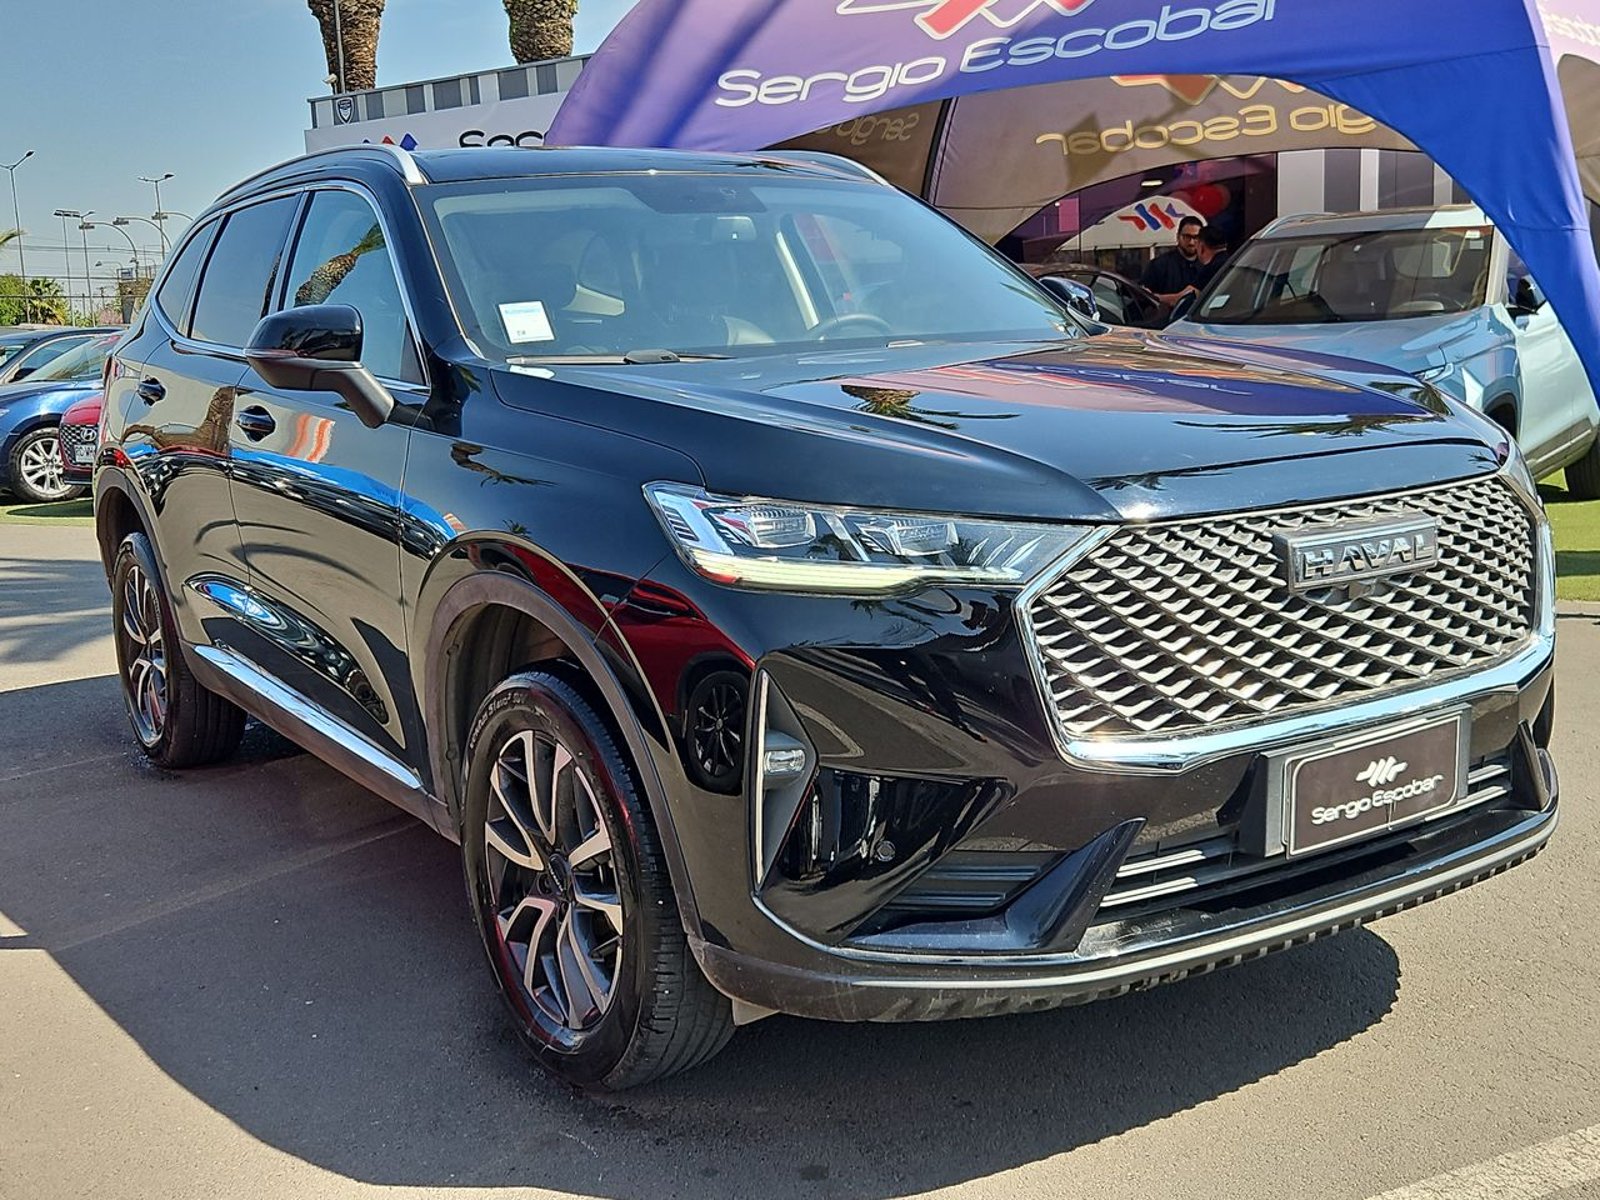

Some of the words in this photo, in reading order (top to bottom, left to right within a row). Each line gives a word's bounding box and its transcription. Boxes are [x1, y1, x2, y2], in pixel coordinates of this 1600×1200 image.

[714, 57, 946, 107] Sergio
[1303, 533, 1433, 578] HAVAL
[1372, 774, 1444, 807] Escobar
